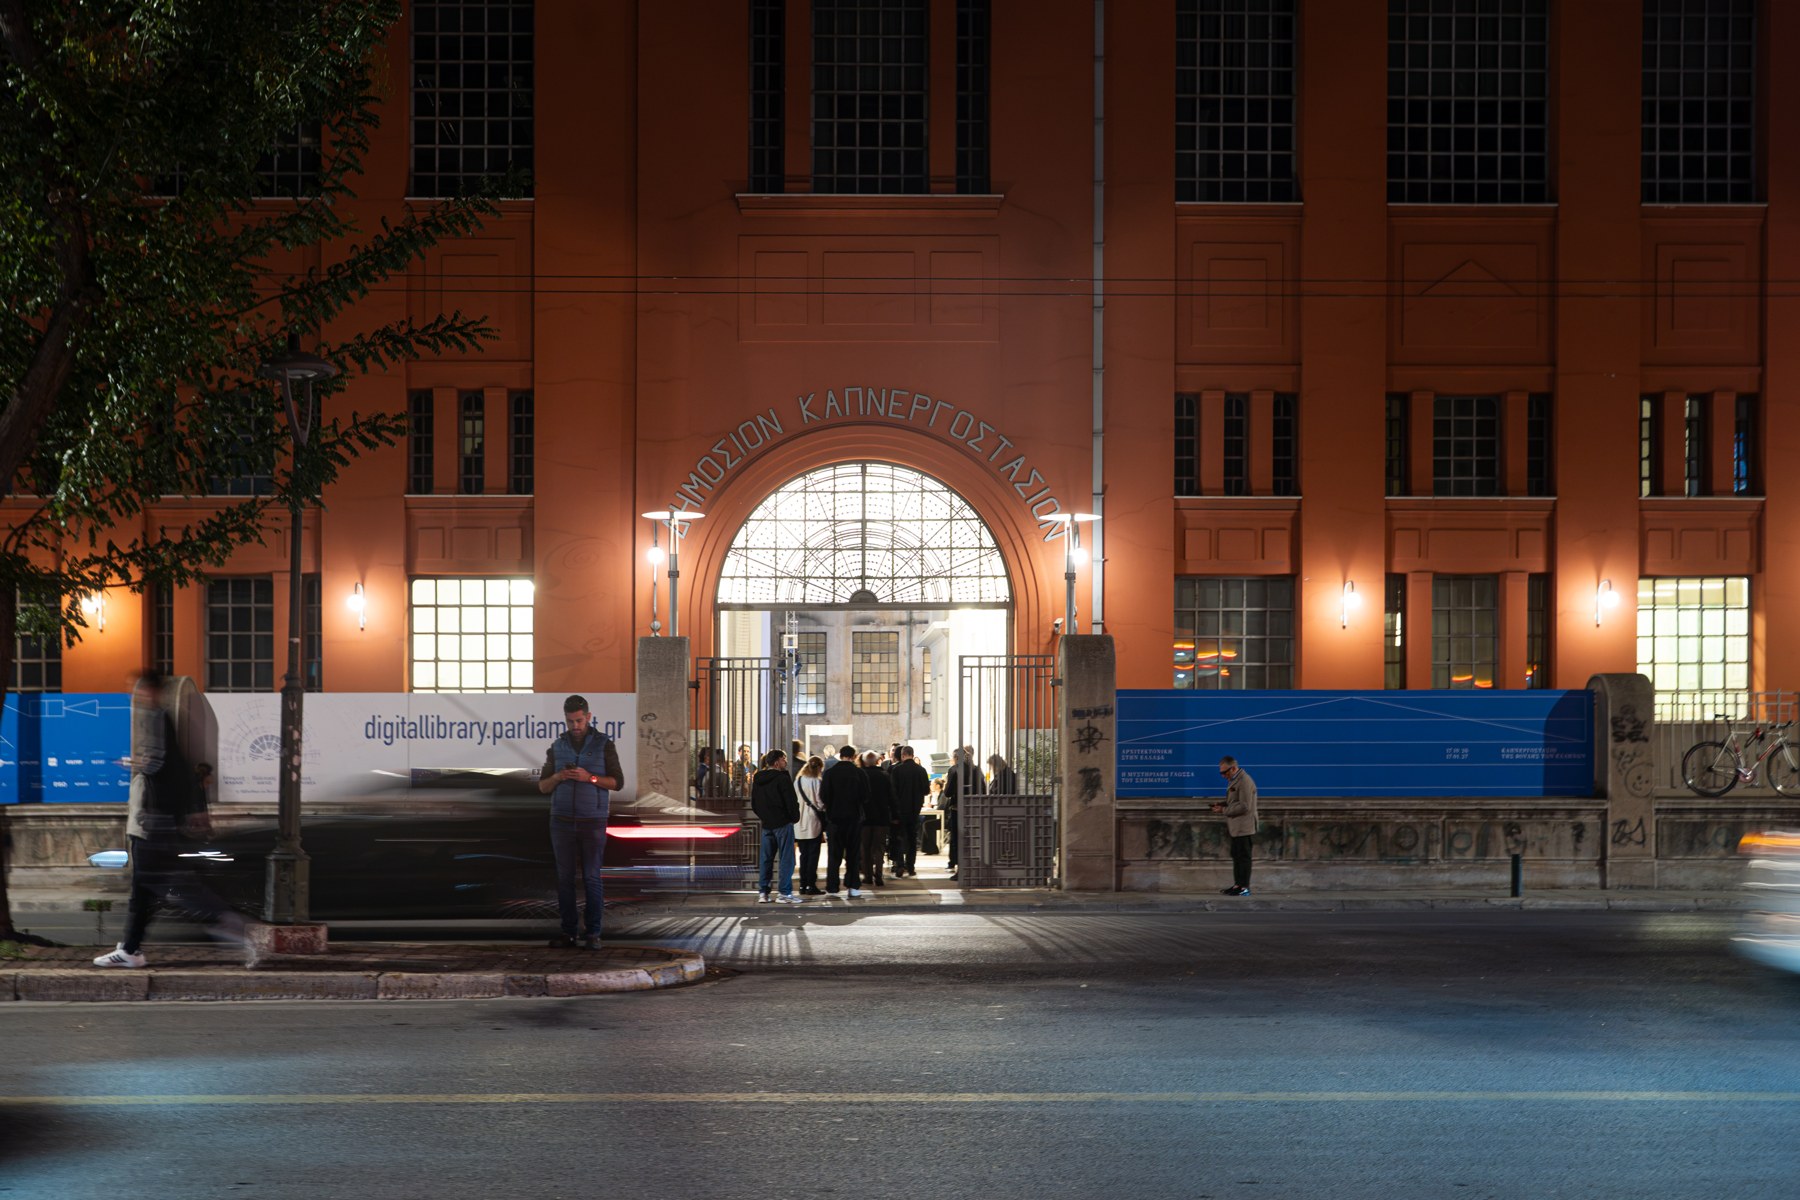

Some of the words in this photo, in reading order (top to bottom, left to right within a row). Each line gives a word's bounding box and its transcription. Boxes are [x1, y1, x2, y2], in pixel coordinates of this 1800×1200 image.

[662, 407, 784, 539] ΔΗΜΟΣΙΟΝ
[797, 387, 1070, 542] ΚΑΠΝΕΡΓΟΣΤΑΣΙΟΝ
[364, 714, 626, 746] digitallibrary.parliamtgr
